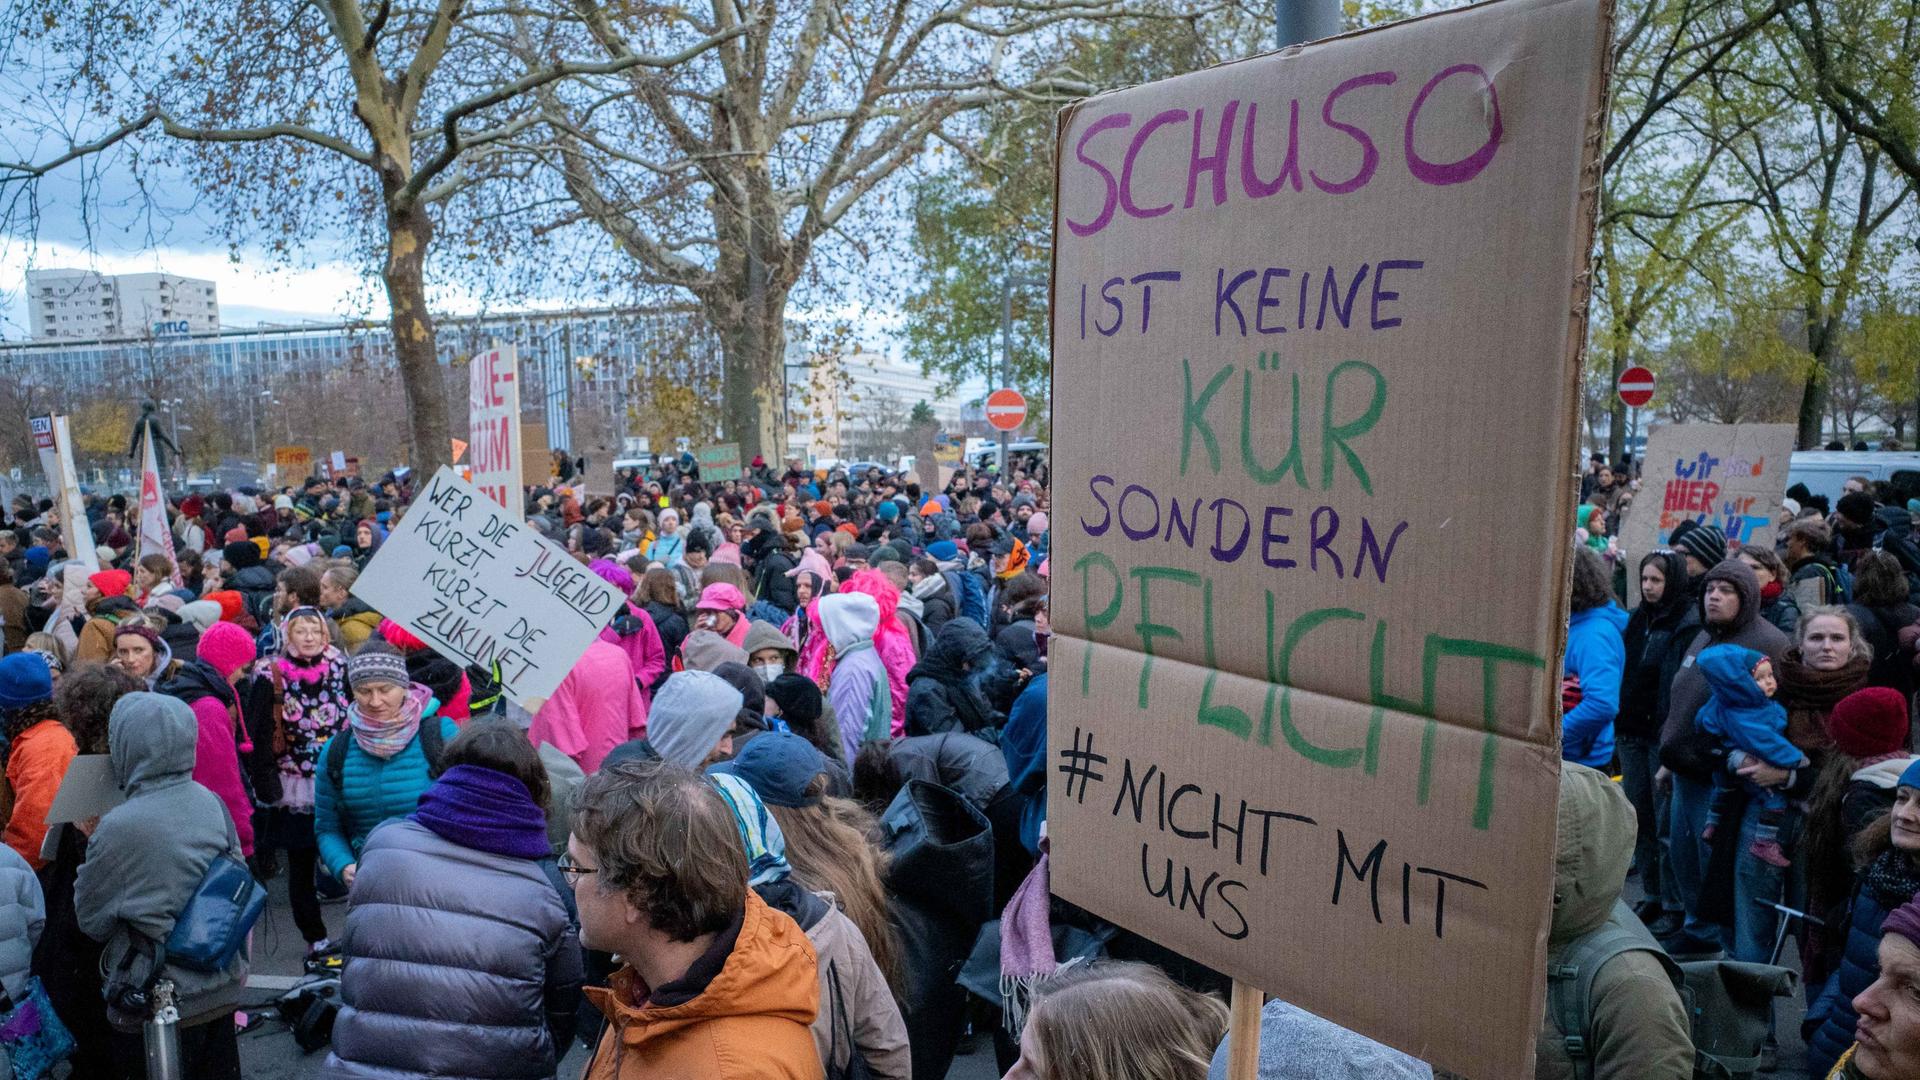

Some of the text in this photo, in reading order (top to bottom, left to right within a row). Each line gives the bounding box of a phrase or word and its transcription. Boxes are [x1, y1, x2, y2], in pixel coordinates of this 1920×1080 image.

[1066, 63, 1504, 237] SCHUSO
[1080, 259, 1425, 340] IST KEINE
[1180, 350, 1388, 497] KÜR
[428, 476, 611, 617] WER DIE JUGEND
[1080, 475, 1409, 583] SONDERN
[1663, 479, 1719, 515] HIER
[416, 597, 540, 685] ZUKUNFT
[422, 561, 547, 654] KÜRZT DIE
[1073, 551, 1546, 831] PFLICHT
[1058, 726, 1489, 939] #NICHT MIT
[1141, 842, 1250, 940] UNS
